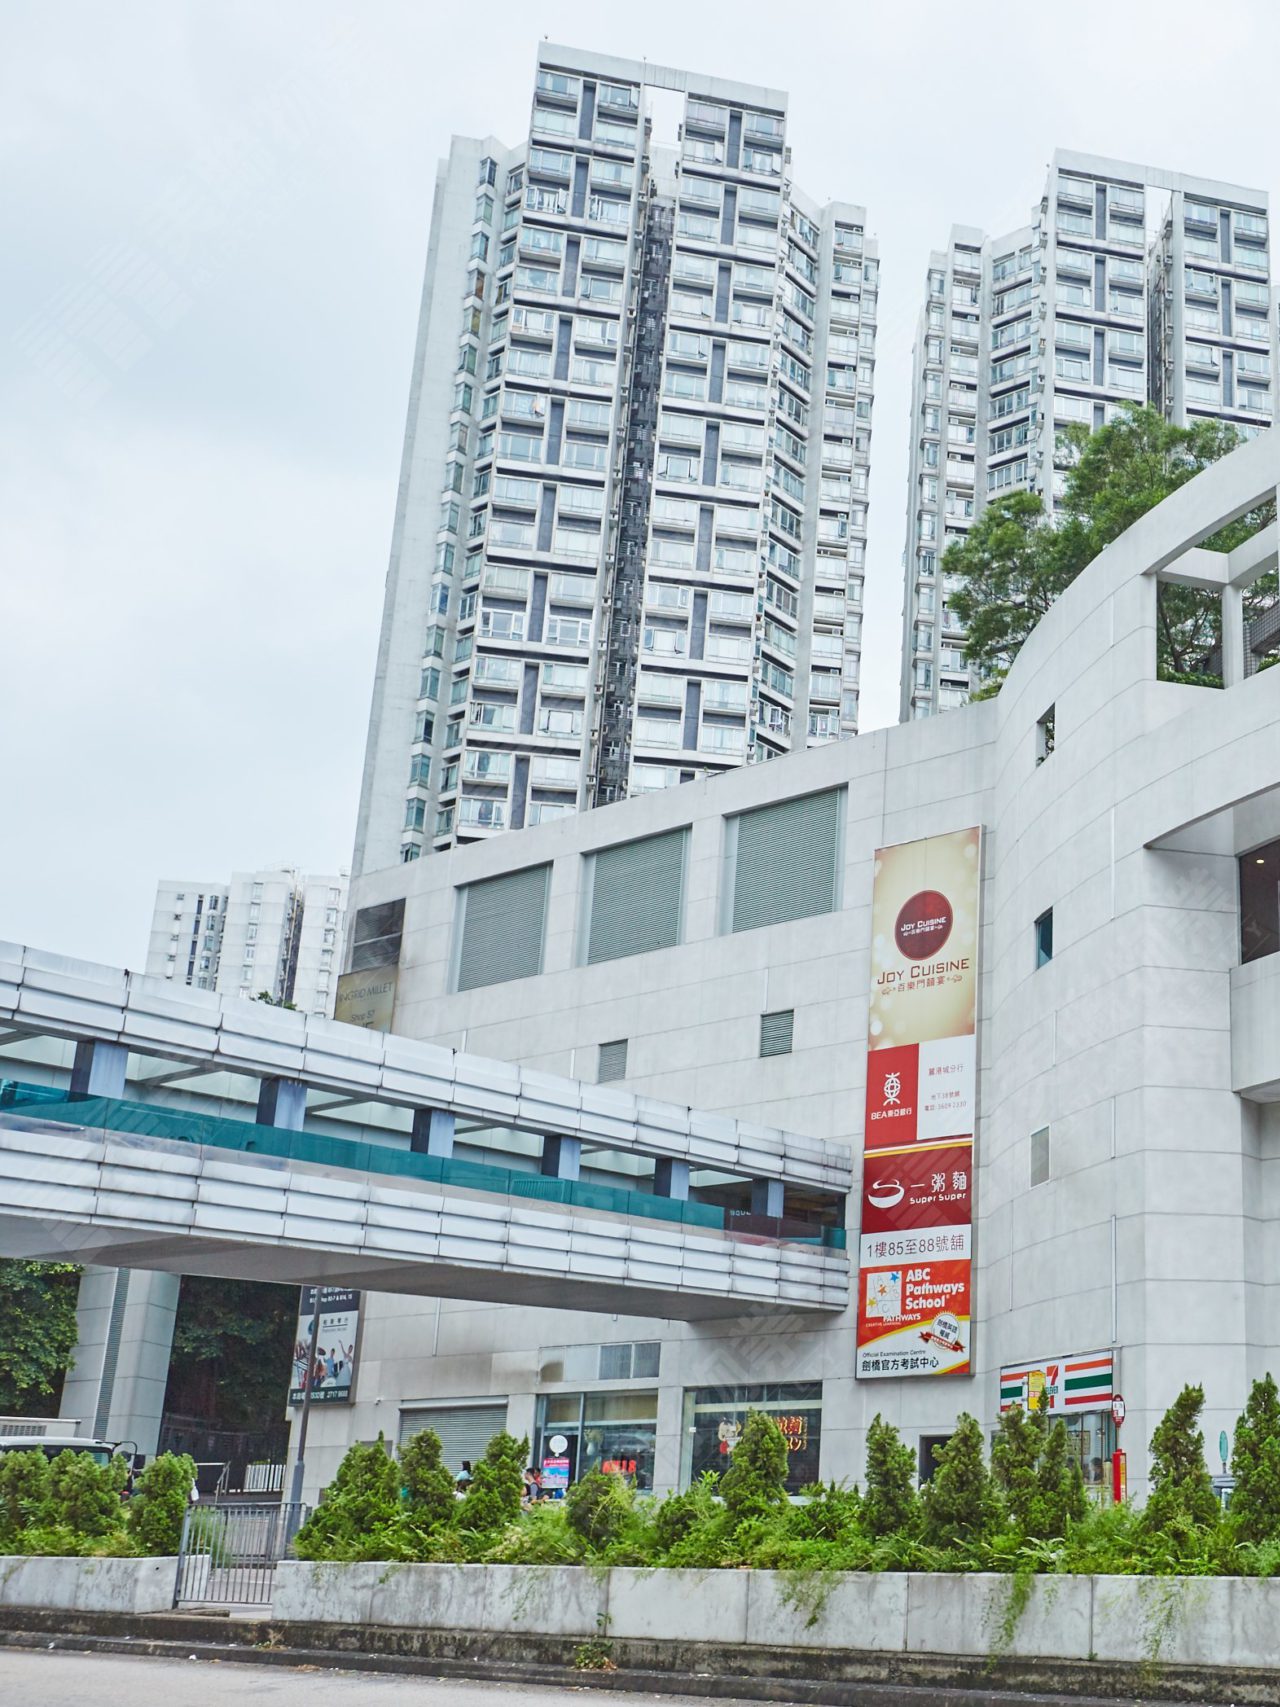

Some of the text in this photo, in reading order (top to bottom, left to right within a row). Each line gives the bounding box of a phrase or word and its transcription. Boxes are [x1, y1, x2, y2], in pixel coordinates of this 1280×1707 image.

[877, 958, 970, 985] JOY CUISINE
[870, 1111, 887, 1120] BEA
[909, 1193, 966, 1205] Super Super
[905, 1267, 931, 1282] ABC
[905, 1282, 965, 1296] Pathways
[905, 1294, 946, 1310] School
[883, 1313, 921, 1322] PATHWAYS
